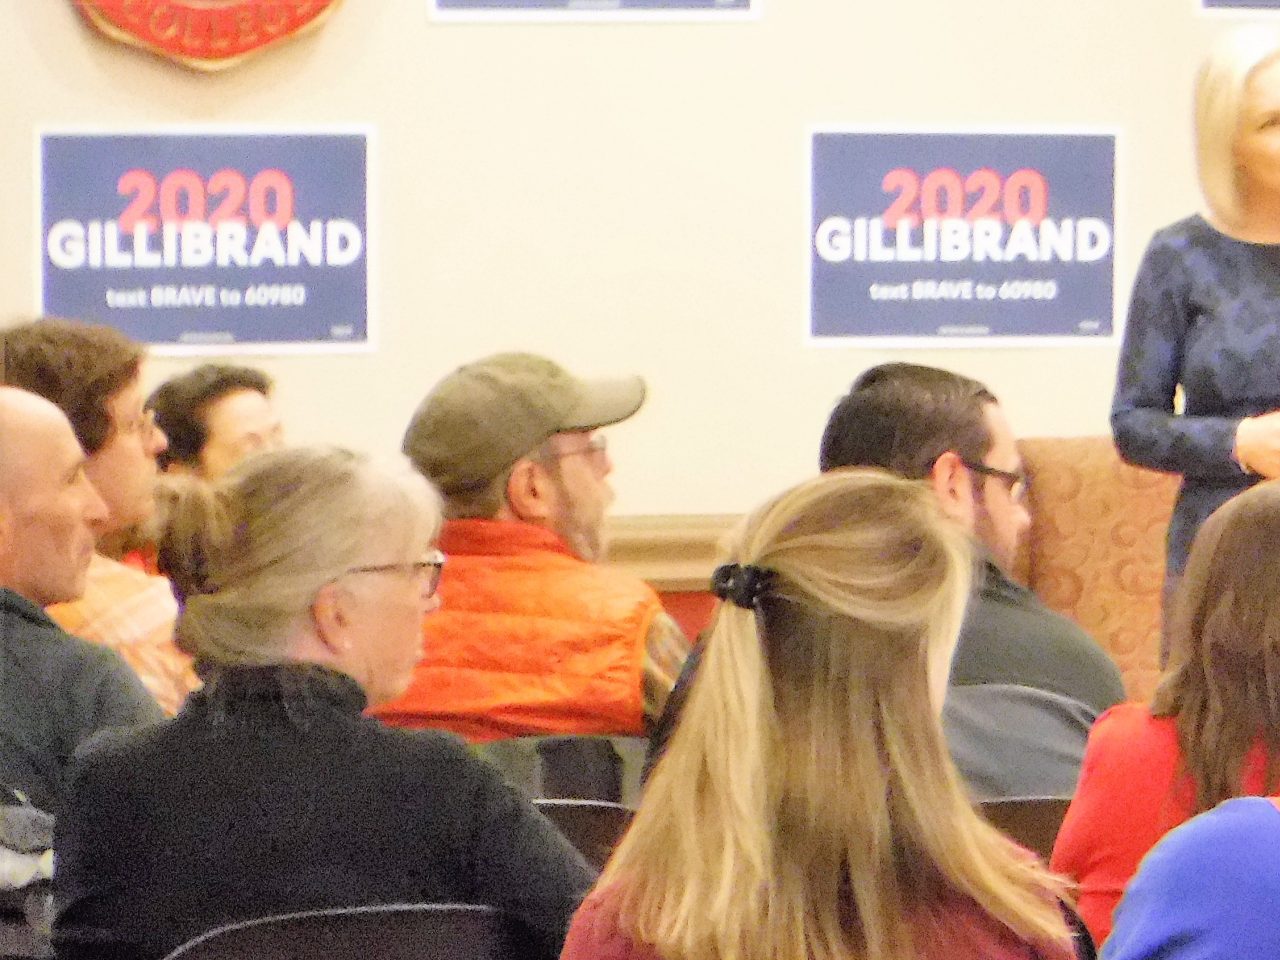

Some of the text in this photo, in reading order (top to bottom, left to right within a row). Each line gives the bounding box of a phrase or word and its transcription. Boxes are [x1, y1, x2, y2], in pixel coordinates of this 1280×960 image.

[116, 167, 296, 234] 2020
[881, 167, 1050, 230] 2020
[47, 218, 363, 269] GILLIBRAND
[815, 215, 1111, 262] GILLIBRAND
[105, 287, 149, 308] text
[150, 284, 217, 307] BRAVE
[219, 288, 242, 306] to
[869, 282, 909, 300] text
[912, 278, 973, 300] BRAVE
[975, 284, 996, 300] to
